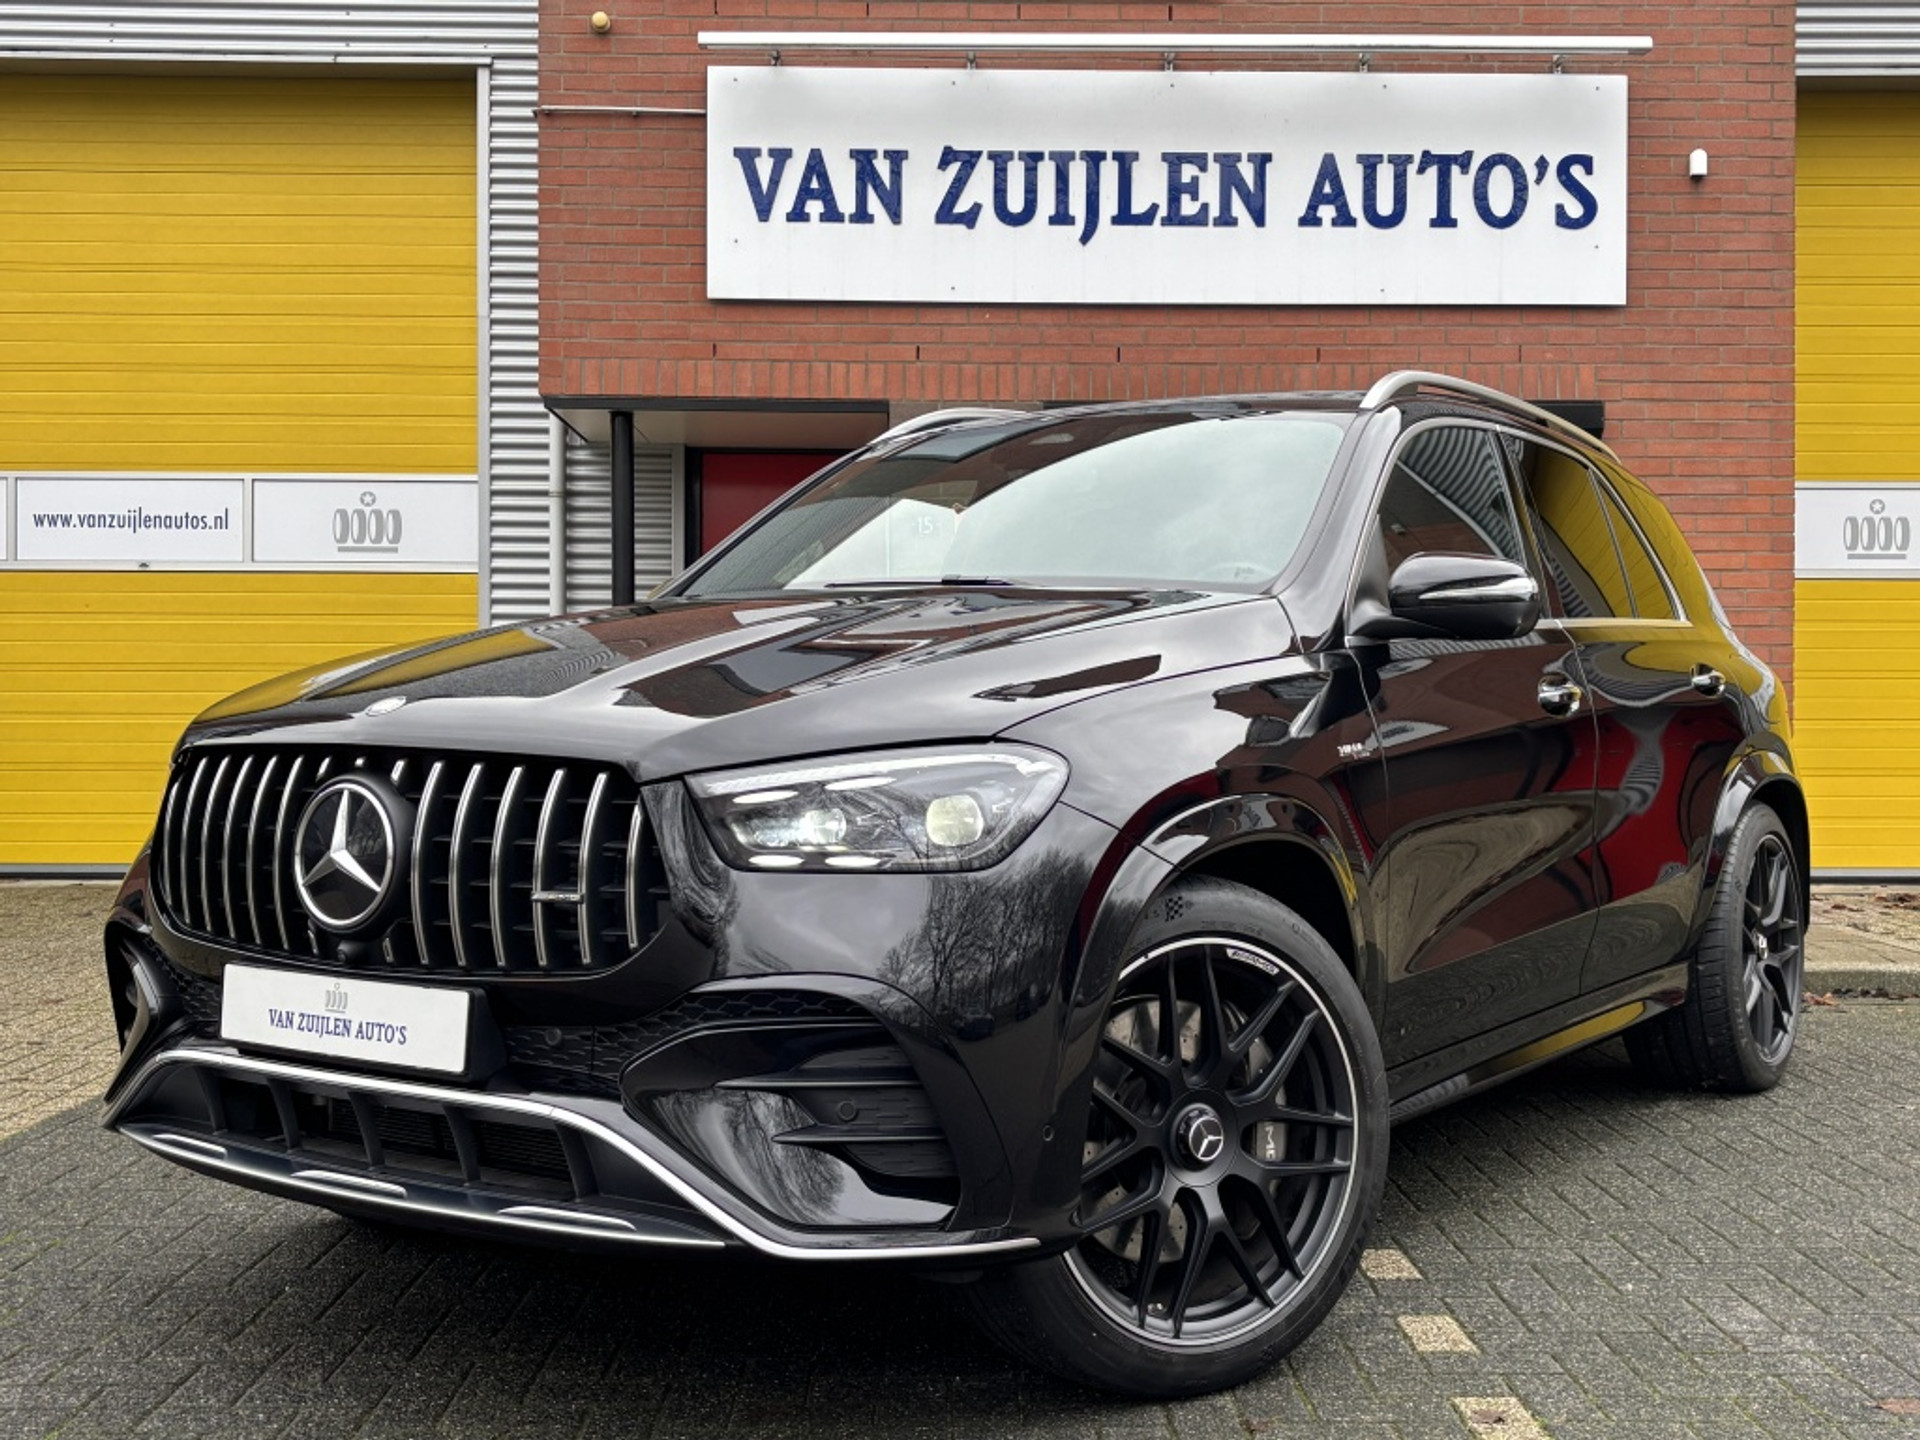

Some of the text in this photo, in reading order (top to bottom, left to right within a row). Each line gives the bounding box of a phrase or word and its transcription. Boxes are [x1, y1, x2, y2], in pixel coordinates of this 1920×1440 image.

[733, 145, 1598, 246] VAN ZUIJLEN AUTO'S
[33, 507, 229, 534] www.vanzuijlenautos.nl
[269, 1008, 407, 1045] VAN ZUIJLEN AUTO'S
